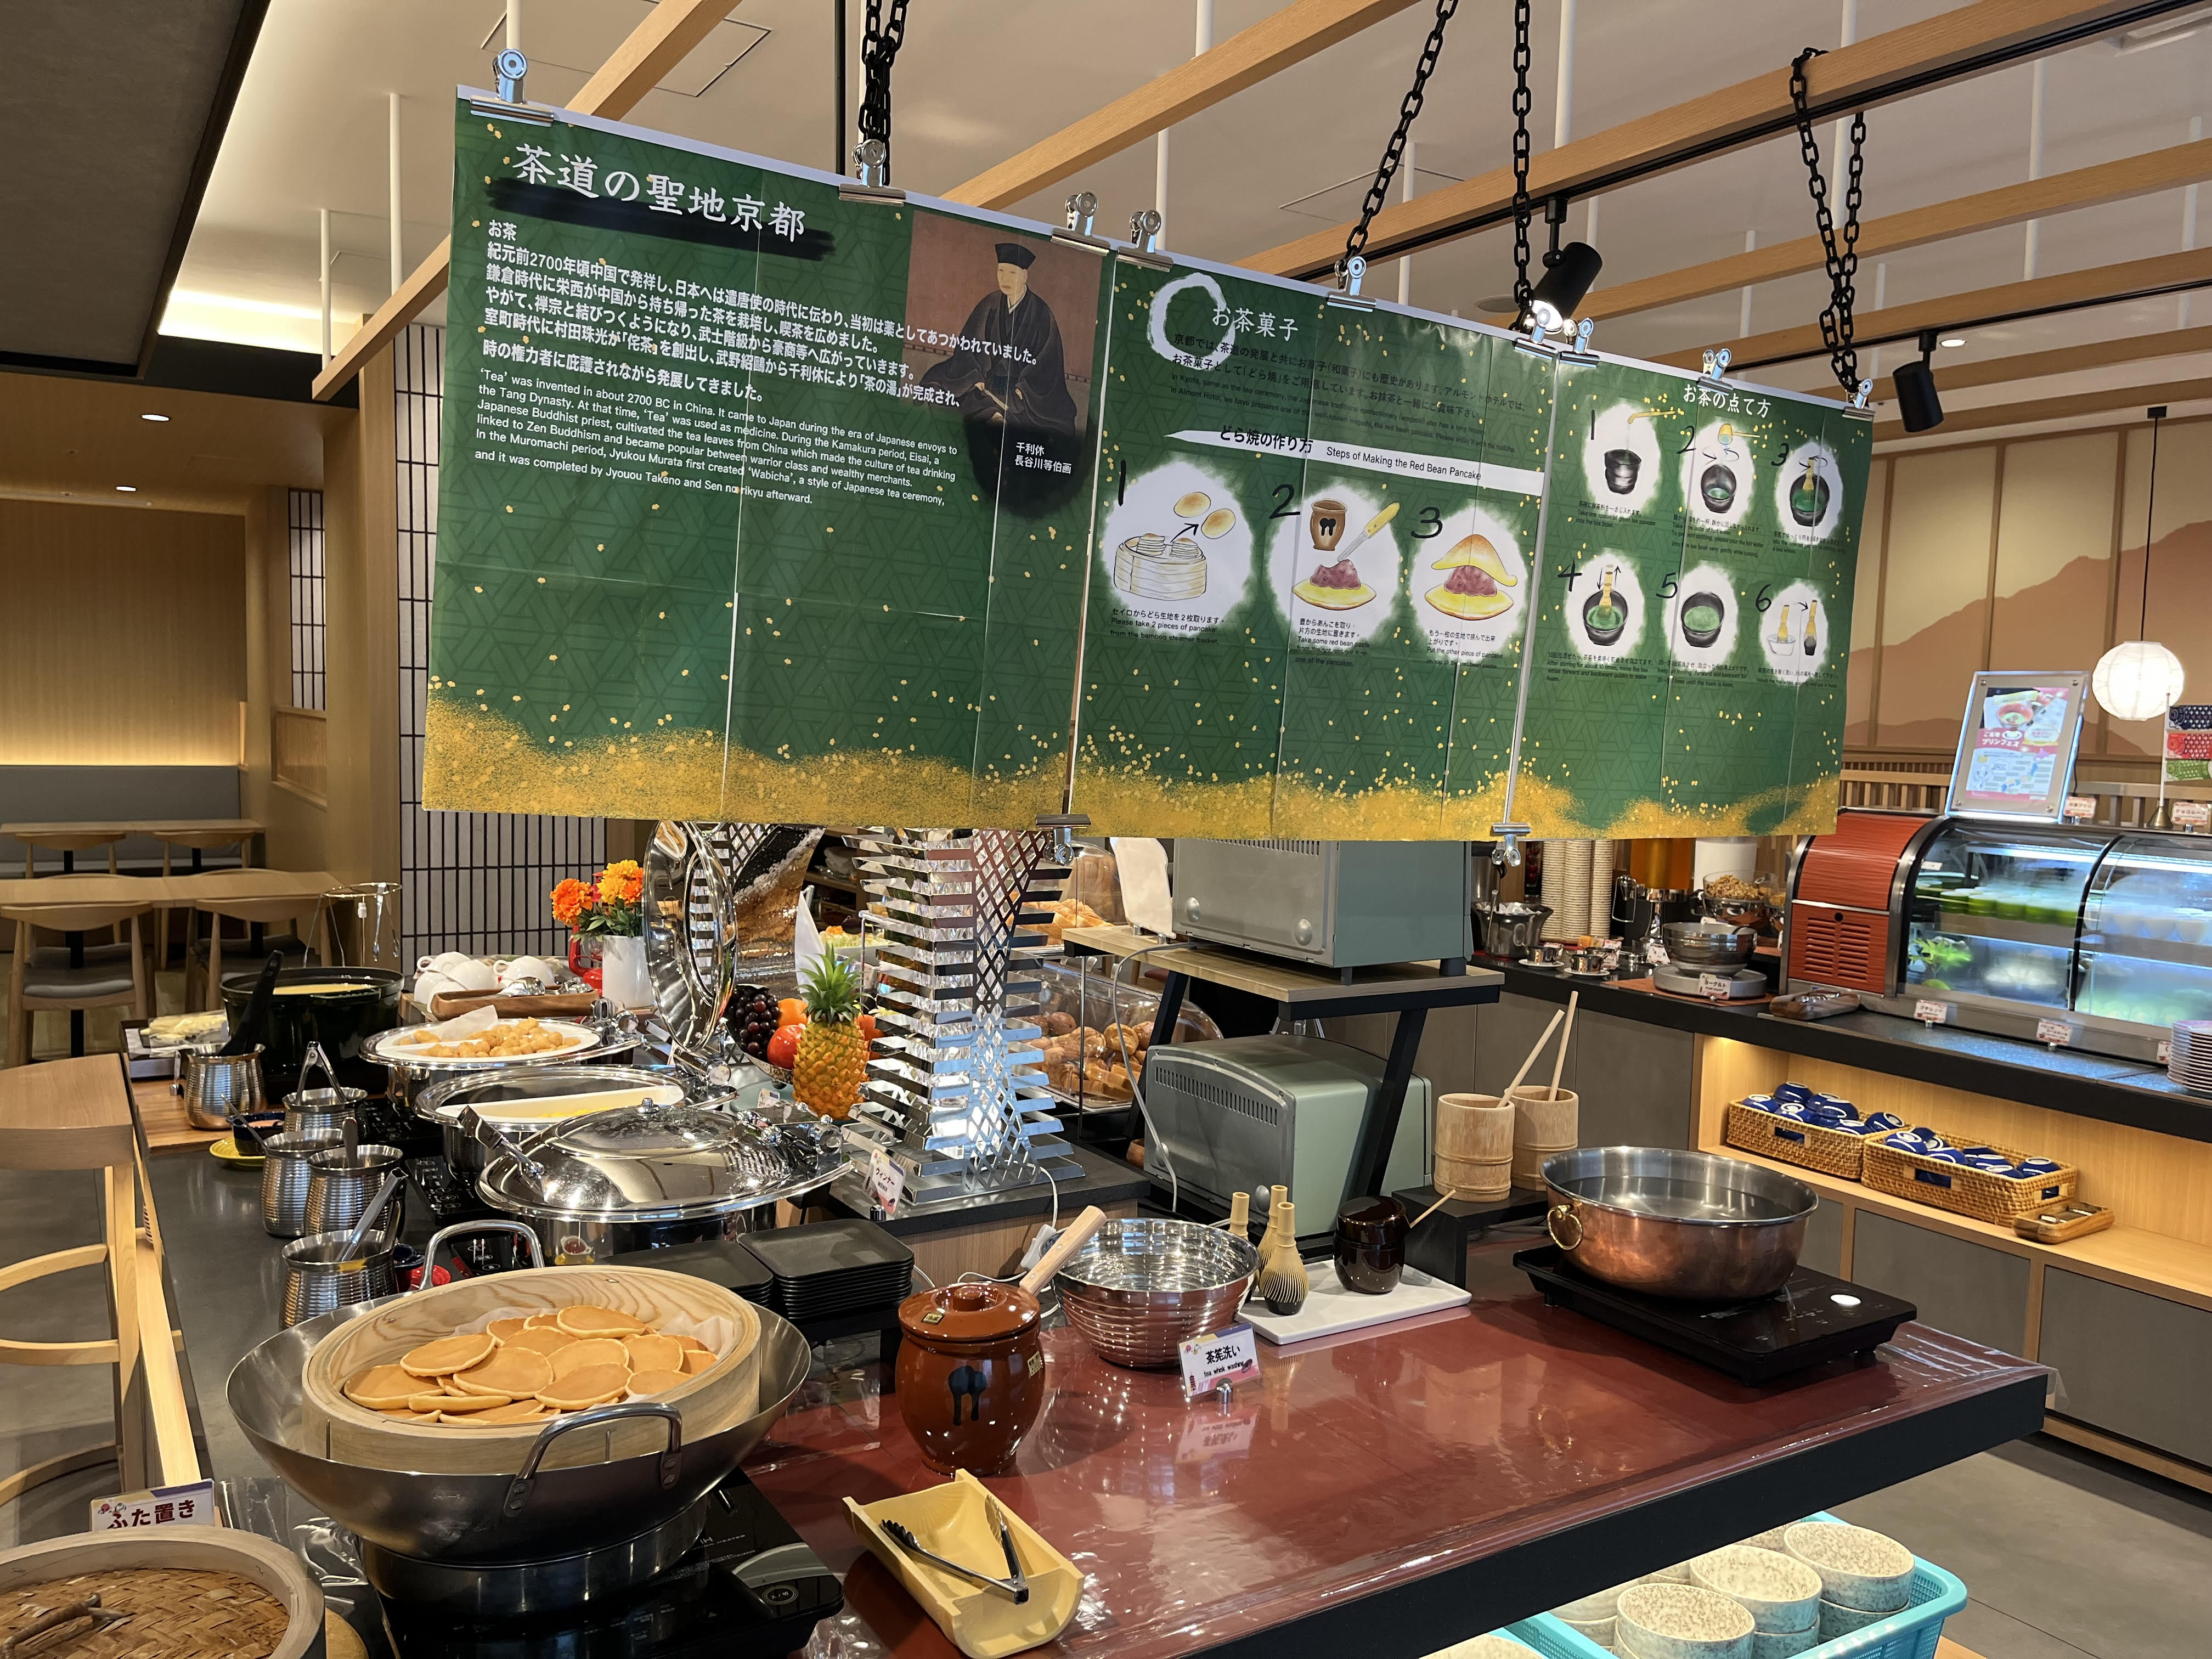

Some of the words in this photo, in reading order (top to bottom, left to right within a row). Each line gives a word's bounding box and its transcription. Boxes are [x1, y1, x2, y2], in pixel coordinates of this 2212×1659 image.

[512, 143, 805, 242] 茶道の聖地京都
[488, 219, 517, 241] お茶
[1212, 307, 1299, 342] お茶菓子
[511, 376, 533, 387] was
[536, 377, 580, 394] invented
[583, 385, 592, 397] in
[596, 388, 625, 402] about
[627, 393, 652, 406] 2700
[655, 397, 670, 413] BC
[673, 400, 682, 411] in
[685, 402, 715, 416] China.
[718, 407, 725, 417] It
[727, 409, 754, 422] came
[757, 414, 766, 424] to
[769, 416, 796, 429] Japan
[799, 421, 828, 436] during
[831, 426, 845, 436] the
[848, 430, 862, 439] era
[865, 432, 874, 441] of
[876, 433, 916, 448] Japanese
[917, 442, 946, 454] envoys
[949, 445, 957, 455] to
[1683, 385, 1771, 418] お茶の点て方
[477, 399, 529, 416] Japanese
[532, 407, 579, 424] Buddhist
[581, 416, 613, 431] priest,
[616, 421, 664, 436] cultivated
[667, 428, 683, 439] the
[686, 431, 701, 442] tea
[704, 433, 734, 447] leaves
[737, 438, 759, 448] from
[762, 442, 788, 455] China
[791, 448, 818, 459] which
[820, 453, 845, 463] made
[848, 455, 862, 466] the
[865, 459, 894, 471] culture
[895, 464, 905, 472] of
[907, 465, 920, 475] tea
[922, 467, 956, 482] drinking
[478, 384, 496, 396] the
[499, 387, 526, 403] Tang
[529, 392, 574, 410] Dynasty.
[577, 399, 590, 411] At
[592, 402, 612, 414] that
[614, 406, 640, 421] time,
[672, 416, 691, 426] was
[694, 420, 718, 430] used
[720, 424, 731, 432] as
[733, 426, 778, 440] medicine.
[781, 431, 811, 447] During
[814, 437, 829, 448] the
[832, 439, 876, 454] Kamakura
[878, 448, 907, 461] period,
[909, 452, 932, 466] Eisai,
[1221, 425, 1313, 455] どら焼の作り方
[1590, 410, 1595, 440] 1
[1677, 425, 1696, 455] 2
[477, 413, 509, 428] linked
[512, 419, 523, 430] to
[526, 421, 546, 433] Zen
[550, 424, 601, 441] Buddhism
[603, 435, 623, 444] and
[625, 436, 665, 450] became
[668, 444, 705, 456] popular
[707, 447, 748, 461] between
[750, 456, 783, 467] warrior
[785, 460, 808, 471] class
[811, 465, 828, 474] and
[831, 467, 865, 481] wealthy
[867, 473, 913, 487] merchants.
[1014, 455, 1072, 475] 長谷川等伯画
[1015, 442, 1045, 456] 千利休
[1327, 447, 1350, 459] Steps
[1363, 453, 1392, 467] Making
[1396, 459, 1407, 467] the
[1410, 461, 1424, 471] Red
[1427, 464, 1447, 474] Bean
[1450, 467, 1481, 479] Pancake
[1771, 443, 1790, 466] 3
[475, 450, 495, 461] and
[499, 452, 506, 462] it
[509, 455, 530, 466] was
[533, 459, 588, 473] completed
[591, 464, 603, 477] by
[606, 467, 642, 481] Jyouou
[645, 472, 681, 486] Takeno
[684, 479, 702, 489] and
[704, 480, 723, 492] Sen
[766, 489, 812, 504] afterward.
[476, 428, 486, 439] In
[489, 430, 507, 442] the
[510, 433, 569, 451] Muromachi
[572, 444, 606, 458] period,
[609, 448, 646, 462] Jyukou
[648, 453, 683, 467] Murata
[685, 458, 706, 470] first
[708, 464, 745, 476] created
[807, 477, 829, 489] style
[831, 480, 842, 489] of
[843, 481, 885, 496] Japanese
[887, 488, 900, 498] tea
[902, 492, 945, 506] ceremony,
[1118, 460, 1126, 506] 1
[1270, 484, 1301, 520] 2
[1410, 506, 1443, 539] 3
[1557, 559, 1583, 592] 4
[1656, 573, 1678, 599] 5
[1756, 584, 1772, 612] 6
[1111, 617, 1133, 626] Please
[1158, 622, 1178, 630] pieces
[1189, 625, 1215, 634] pancake
[1205, 1345, 1240, 1364] 茶筅洗い
[107, 1499, 195, 1529] ふた置き
